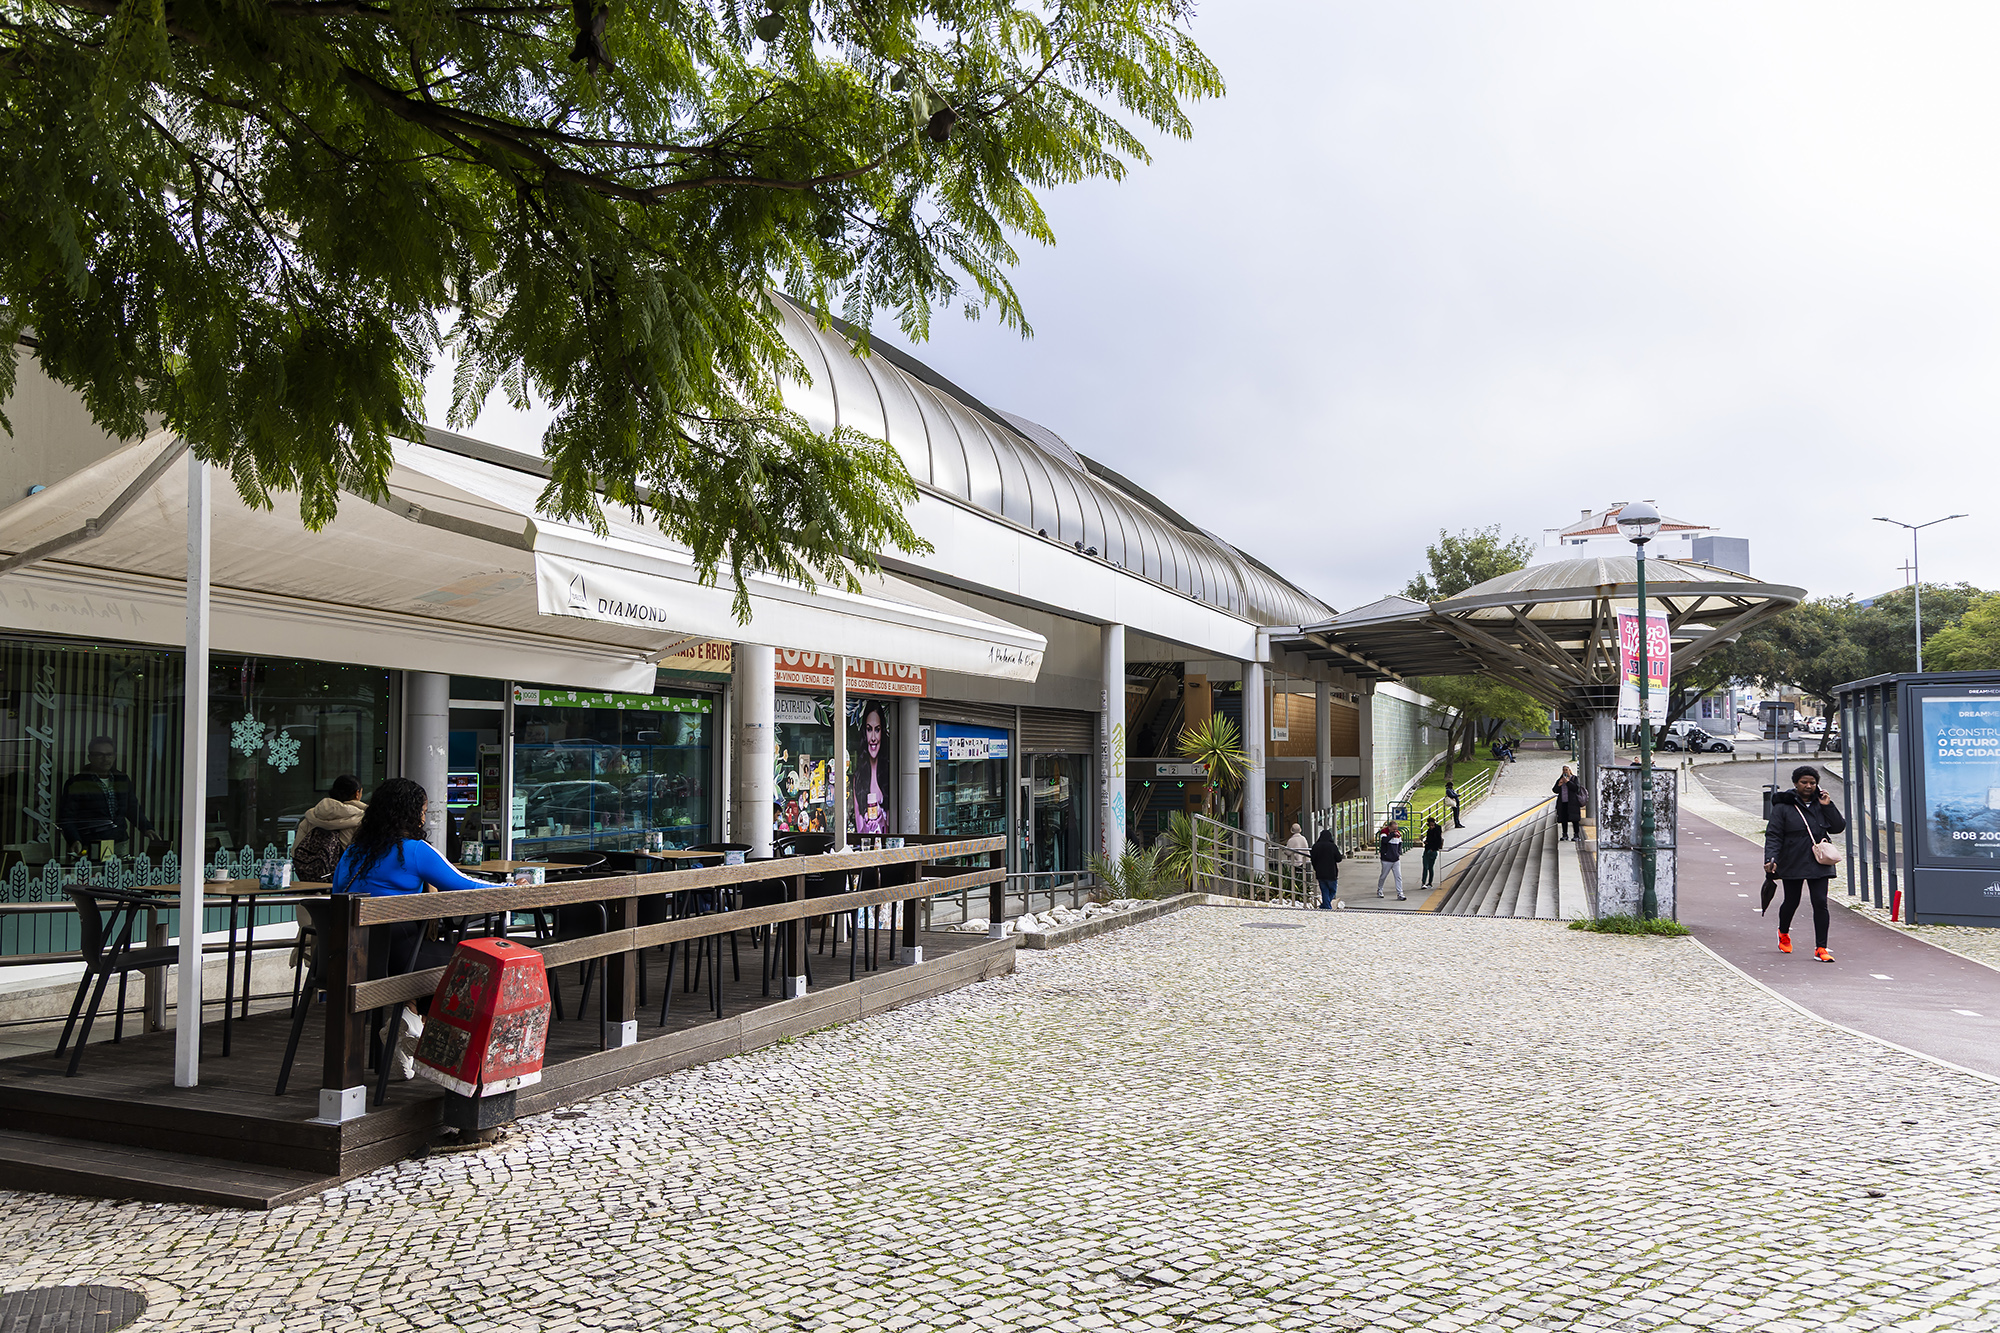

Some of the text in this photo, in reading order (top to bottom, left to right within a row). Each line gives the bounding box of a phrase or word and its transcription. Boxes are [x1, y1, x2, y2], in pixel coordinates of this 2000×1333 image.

[598, 597, 668, 623] DIAMOND
[705, 642, 732, 662] REVIS
[801, 674, 820, 684] VENDA
[822, 676, 830, 685] DE
[523, 692, 537, 700] JOGOS
[781, 699, 812, 714] EXTRATUS
[1937, 728, 1946, 736] A
[1937, 738, 1999, 747] O FUTURO
[1938, 748, 1964, 757] DAS
[22, 752, 54, 844] adaria
[1393, 808, 1403, 820] P
[1952, 831, 2000, 841] 808 200
